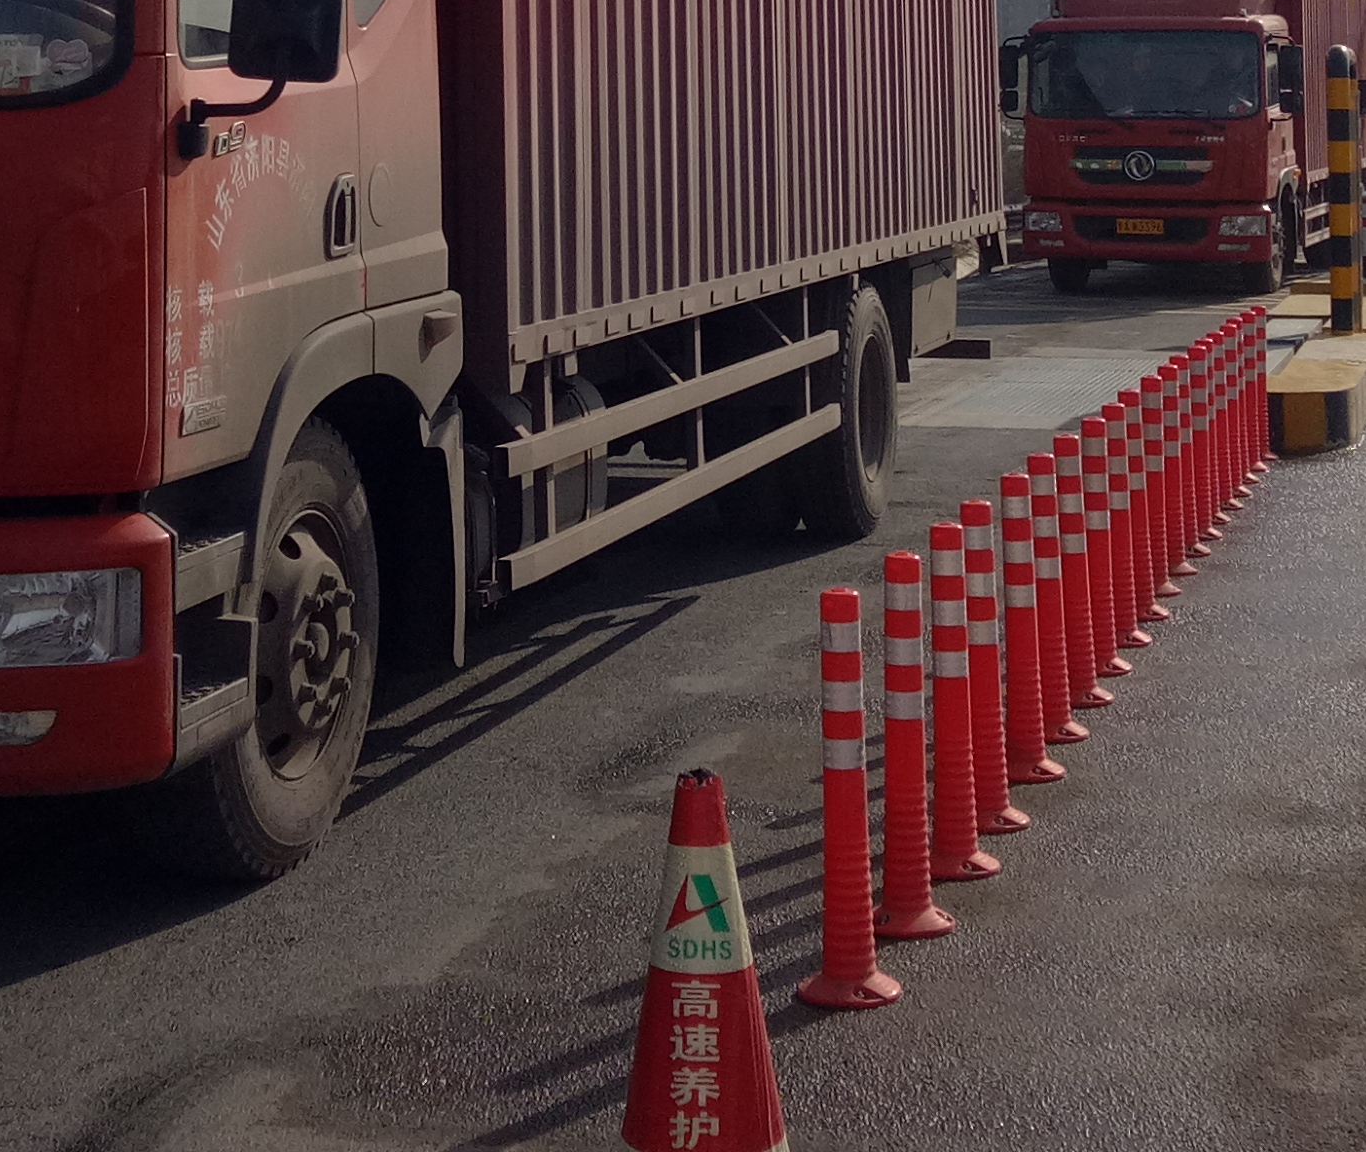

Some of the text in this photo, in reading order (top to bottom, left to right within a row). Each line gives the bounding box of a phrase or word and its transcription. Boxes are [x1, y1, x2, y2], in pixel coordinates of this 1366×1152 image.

[212, 120, 247, 158] D9
[666, 939, 733, 961] SDHS
[669, 980, 721, 1151] 高速养护
